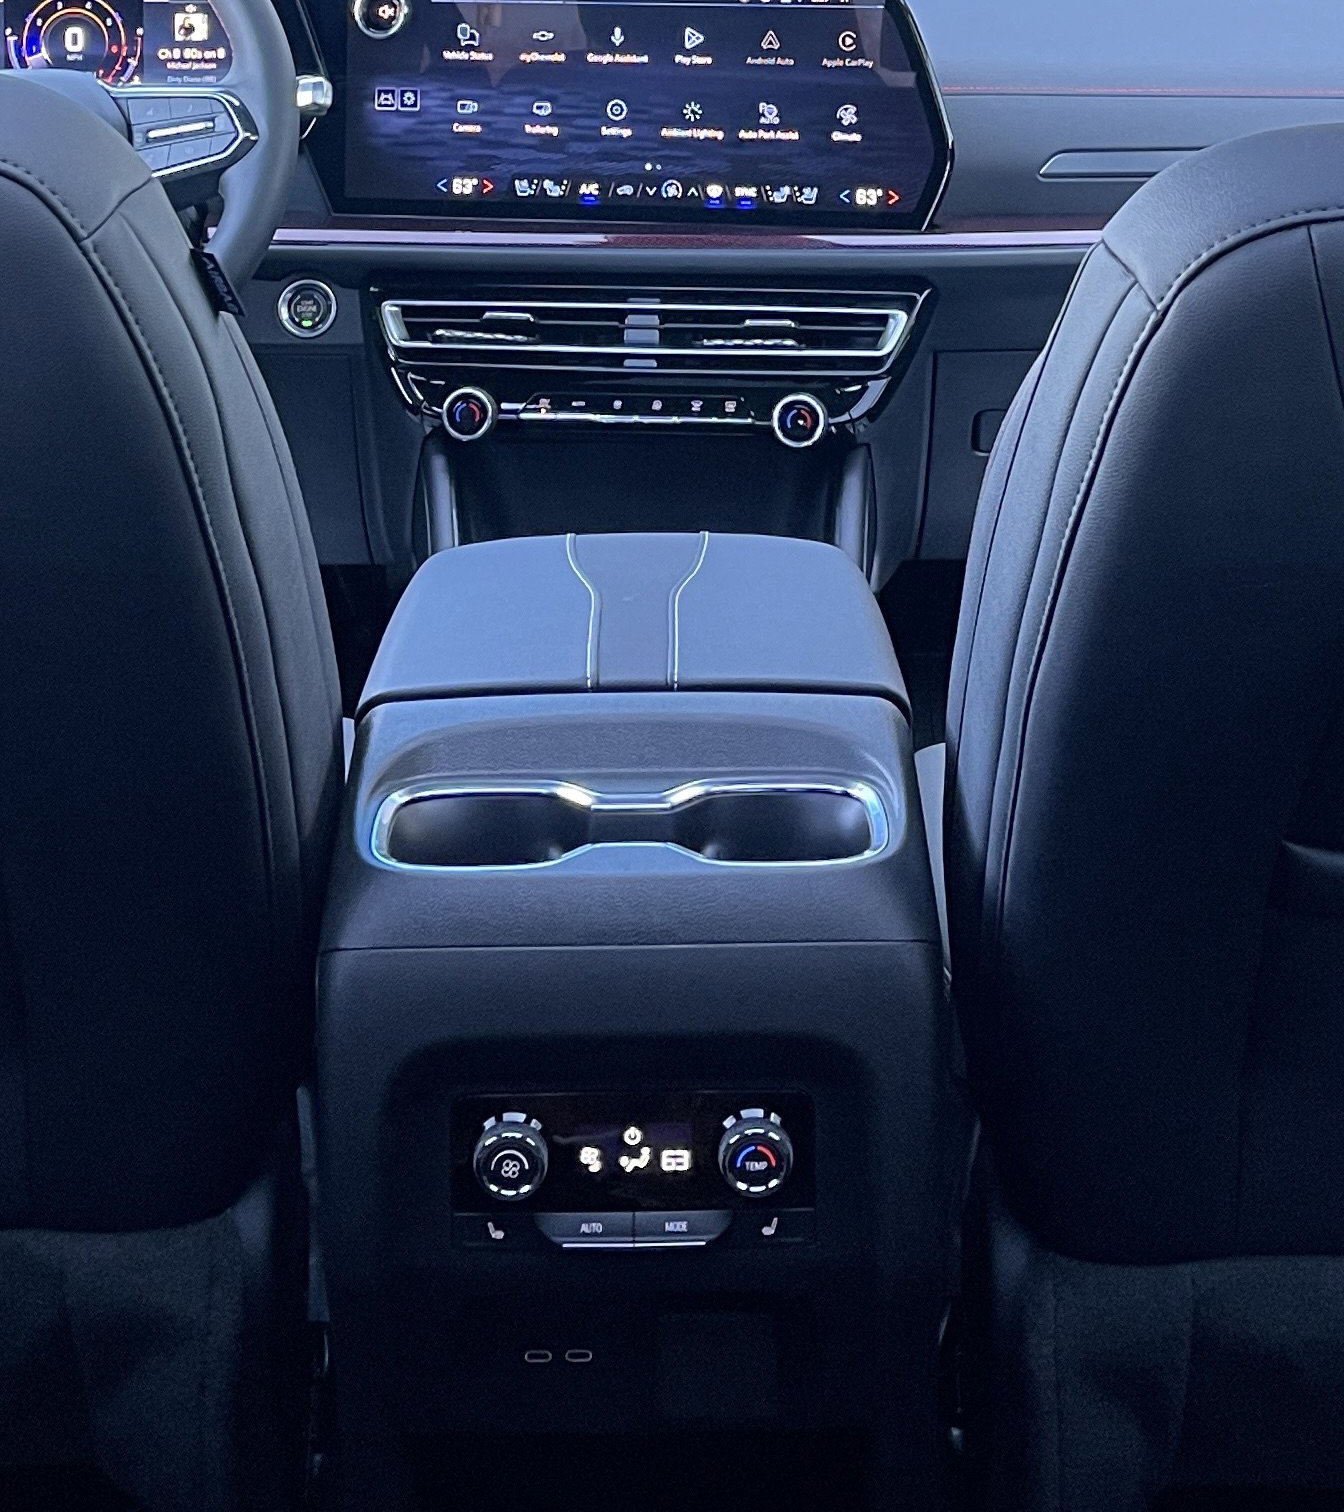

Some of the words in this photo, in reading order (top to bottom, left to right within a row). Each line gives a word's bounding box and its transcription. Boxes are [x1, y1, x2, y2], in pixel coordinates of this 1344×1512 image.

[64, 26, 84, 53] 0
[442, 50, 469, 61] Vehicle
[586, 52, 614, 65] Google
[674, 54, 692, 66] Play
[691, 55, 713, 66] Store
[746, 56, 776, 66] Android
[776, 56, 795, 66] Auto
[166, 62, 192, 70] Michael
[821, 57, 844, 68] Apple
[845, 58, 874, 69] CarPlay
[452, 123, 482, 133] Camera
[600, 126, 633, 138] Settings
[660, 1149, 690, 1171] 63
[745, 1161, 768, 1171] TEMP
[579, 1222, 603, 1234] AUTO
[664, 1221, 688, 1232] MODE
